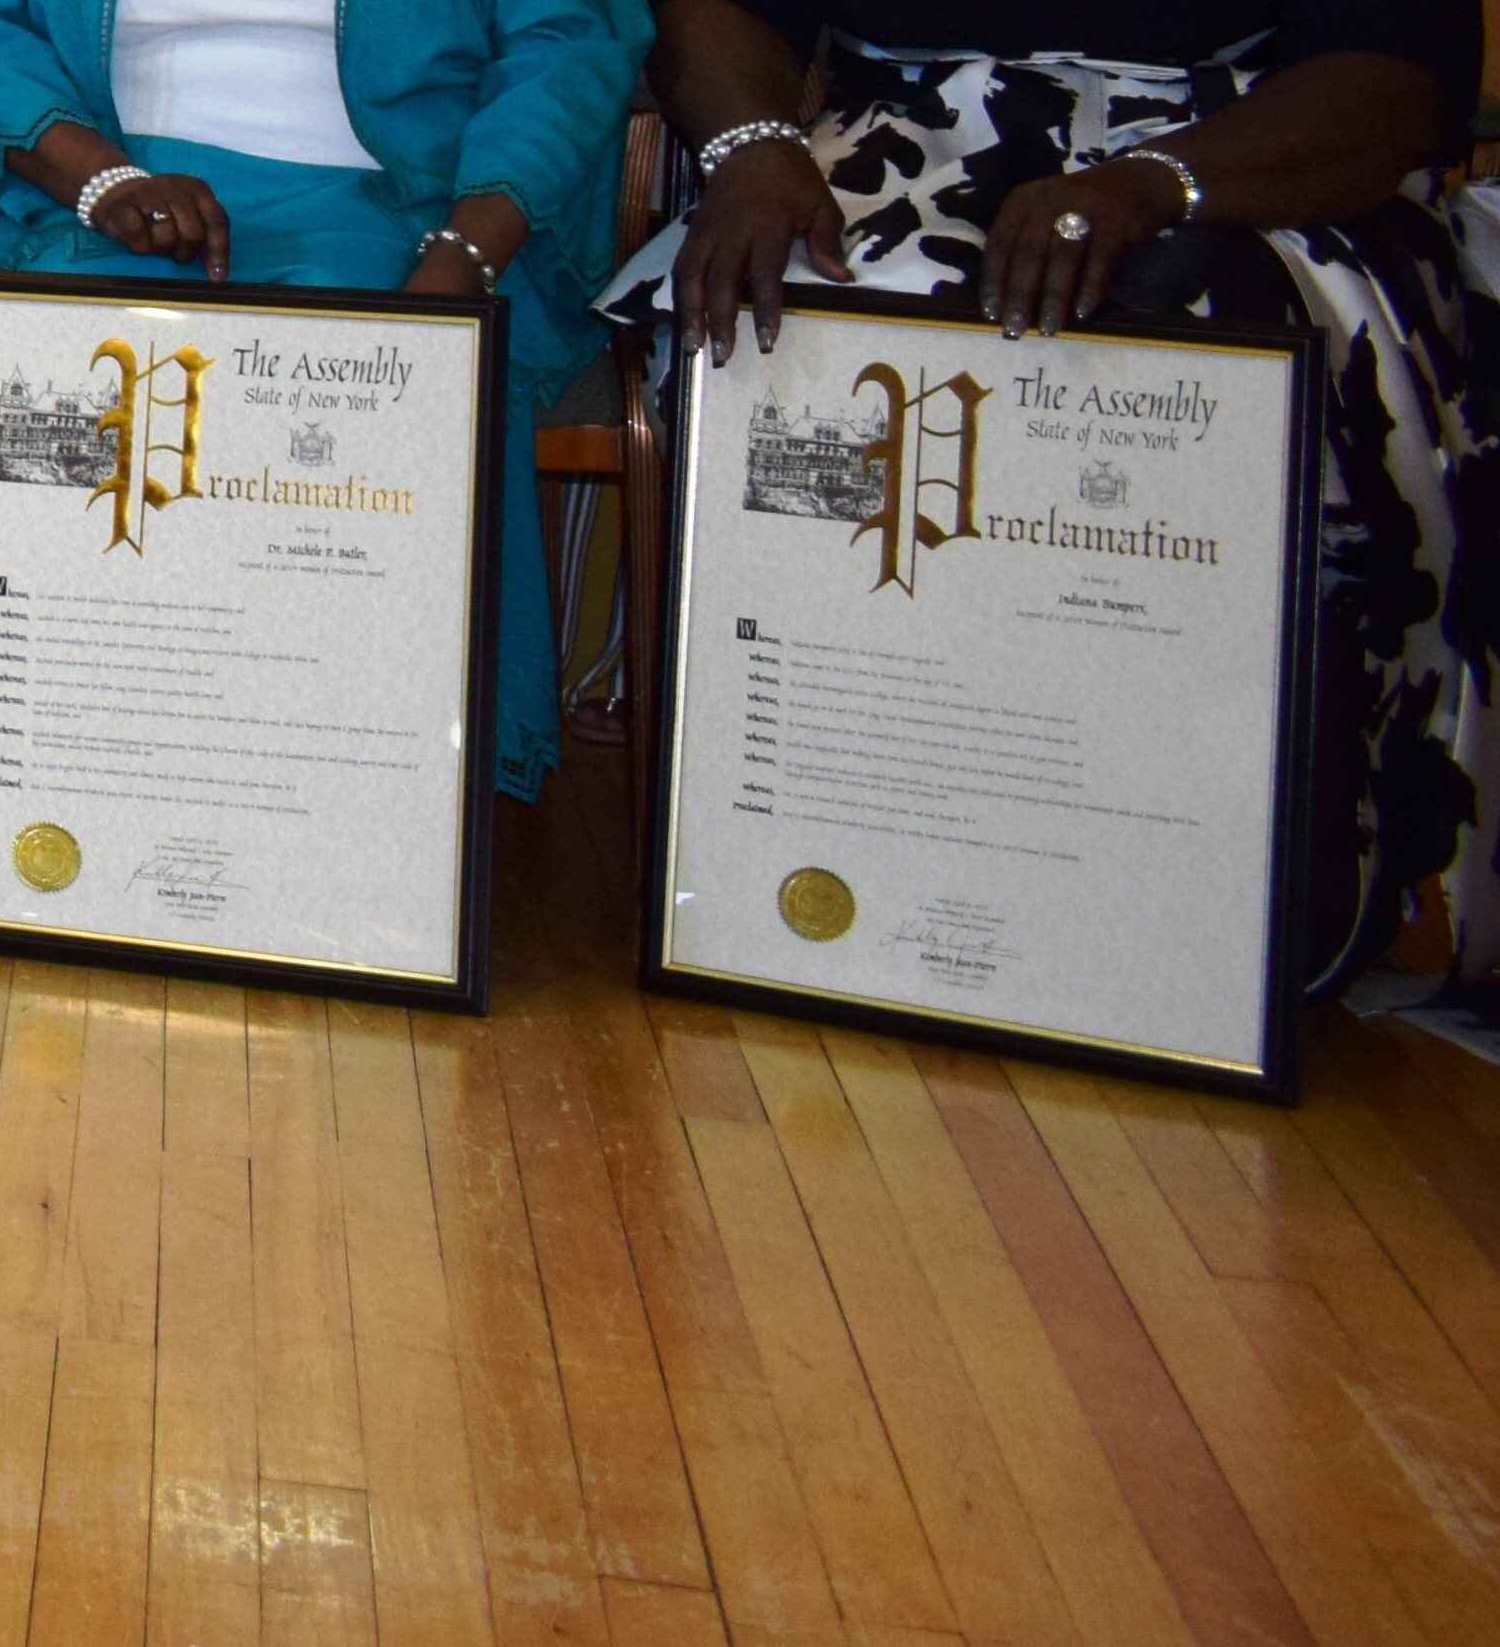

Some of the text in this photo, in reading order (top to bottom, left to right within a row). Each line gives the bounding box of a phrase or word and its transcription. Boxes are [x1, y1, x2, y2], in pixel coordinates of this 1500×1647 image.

[232, 339, 414, 403] The Assembly
[244, 385, 378, 415] State of New York
[1013, 368, 1218, 442] The Assembly
[85, 338, 415, 559] Proclamation
[1026, 418, 1179, 453] State of New York
[849, 361, 1219, 600] Proclamation
[268, 544, 282, 554] Dr.
[1058, 591, 1148, 618] Indiana Bumpers,
